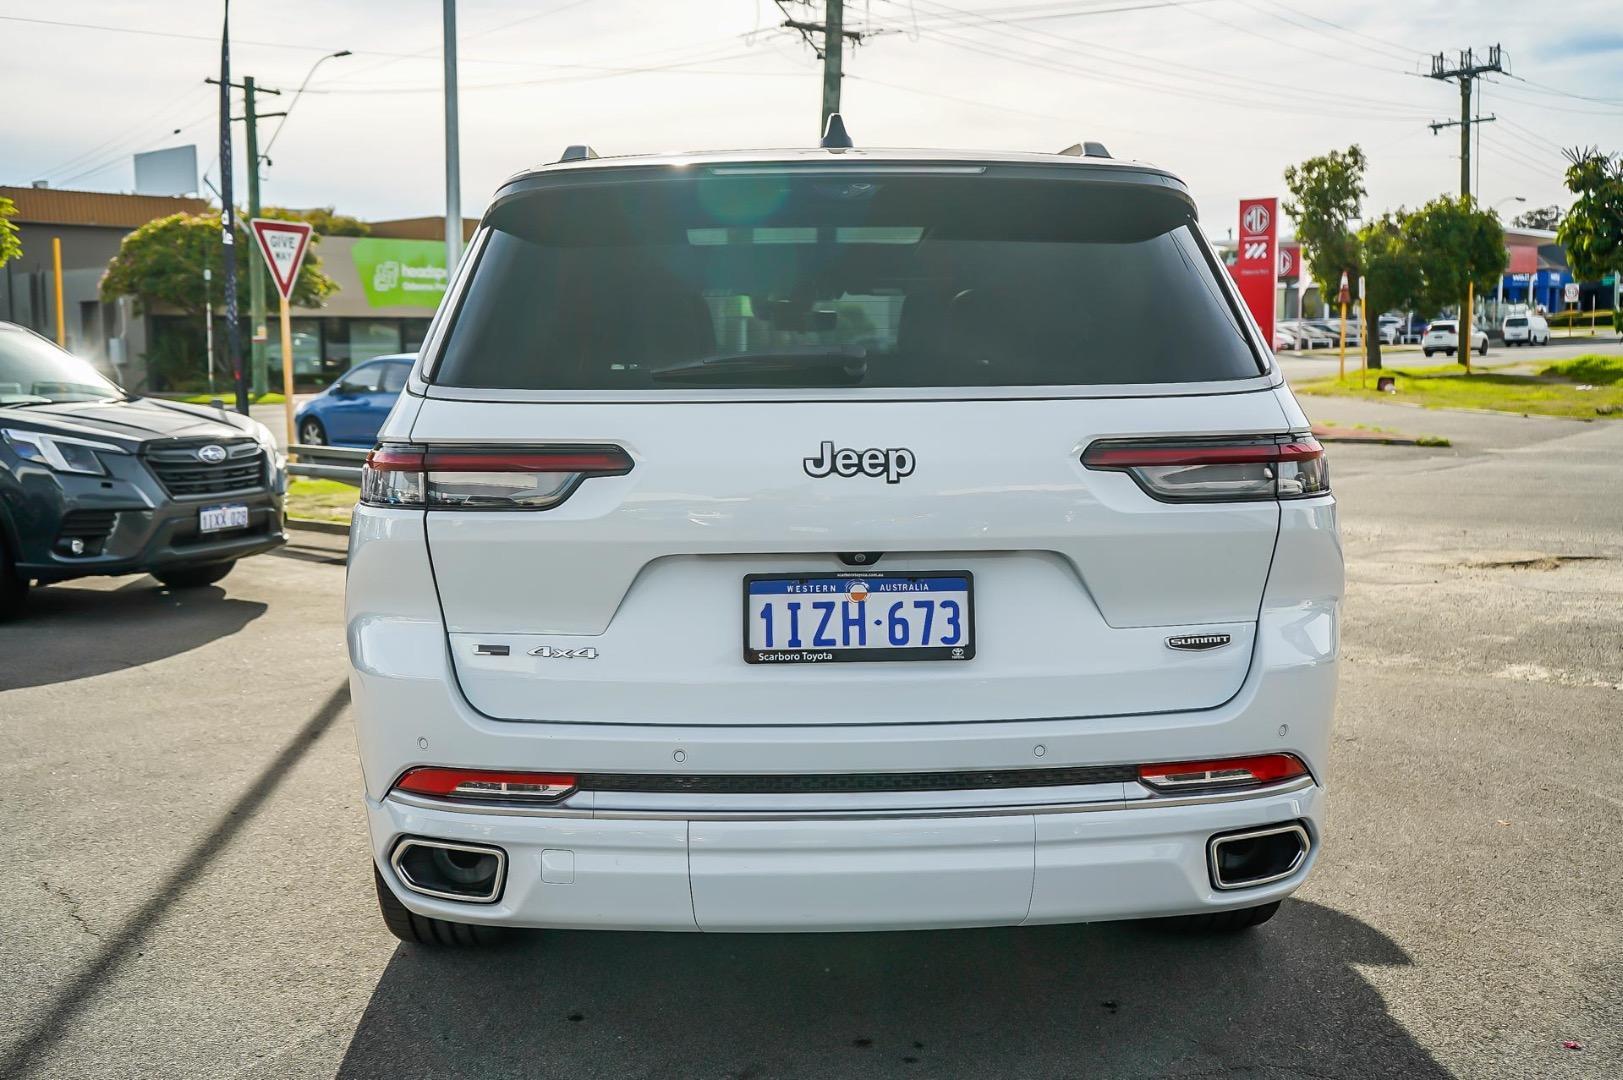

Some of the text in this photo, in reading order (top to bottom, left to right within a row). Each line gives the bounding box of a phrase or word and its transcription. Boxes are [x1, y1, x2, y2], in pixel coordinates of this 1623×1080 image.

[1244, 206, 1269, 233] MG
[270, 234, 295, 249] GIVE
[275, 252, 292, 260] WAY
[803, 441, 916, 484] Jeep
[787, 583, 929, 593] WESTERN AUSTRALIA
[527, 646, 599, 659] 4x4
[758, 652, 833, 662] Scarboro Toyota
